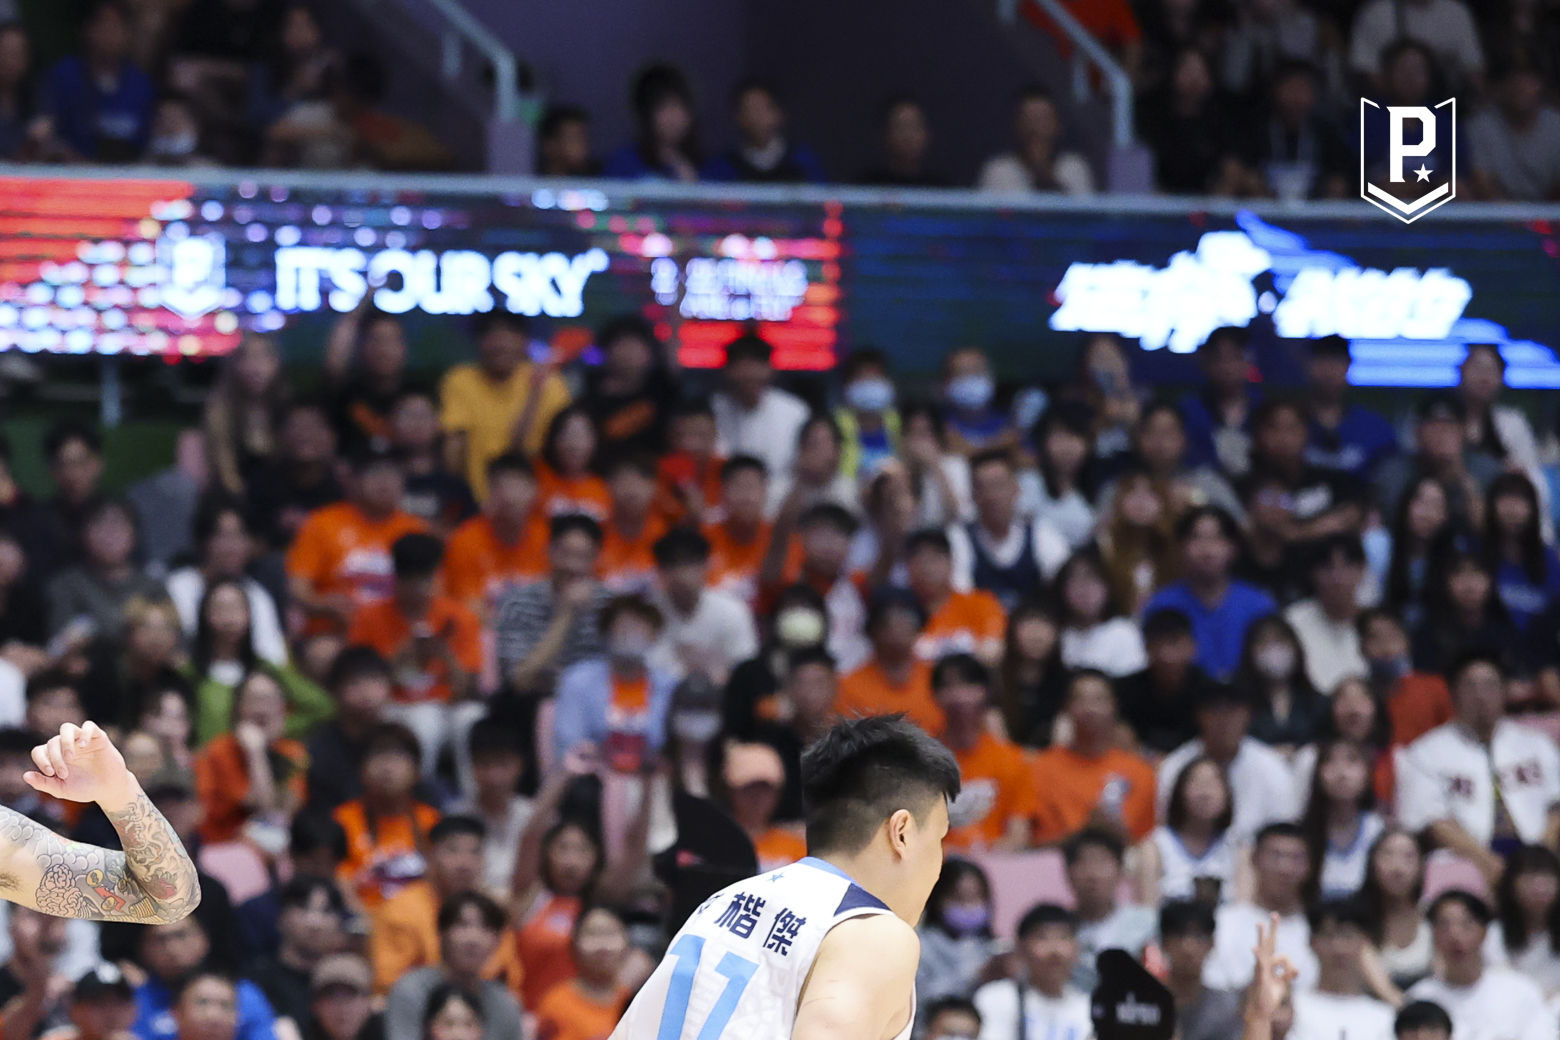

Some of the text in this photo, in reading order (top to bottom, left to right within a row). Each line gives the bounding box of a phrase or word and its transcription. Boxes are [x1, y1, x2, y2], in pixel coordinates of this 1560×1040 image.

[275, 247, 366, 313] IT'S
[367, 248, 494, 315] OUR
[698, 892, 807, 957] 楷傑
